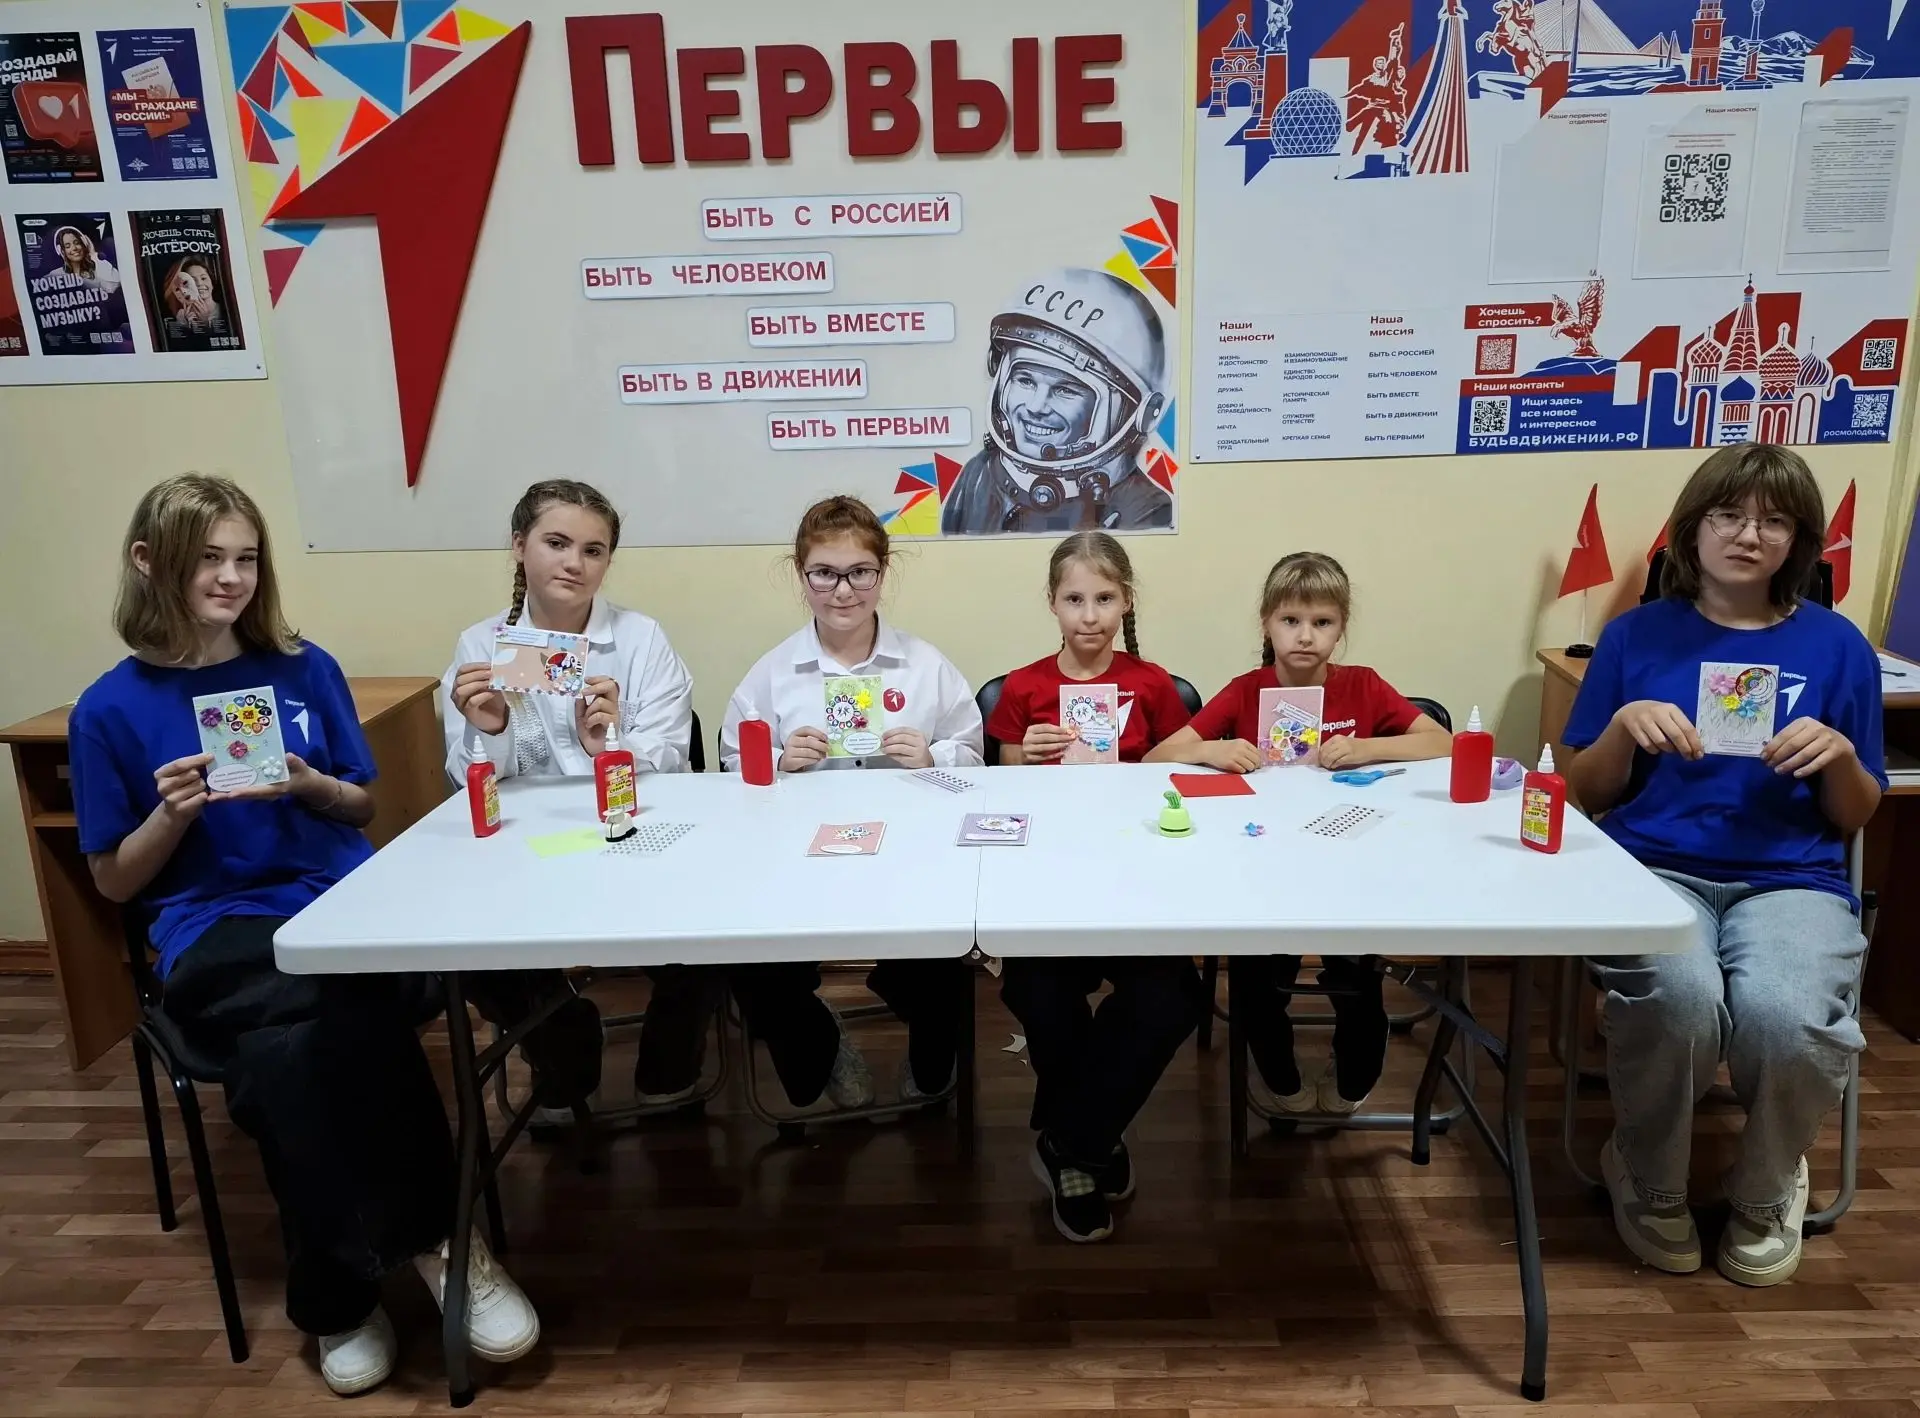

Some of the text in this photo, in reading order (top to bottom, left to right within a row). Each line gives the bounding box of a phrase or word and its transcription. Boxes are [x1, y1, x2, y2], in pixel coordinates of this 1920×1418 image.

[0, 48, 78, 71] ОЗДАВАЙ
[0, 67, 58, 85] РЕНДЫ
[134, 101, 198, 112] ГРАЖДАНЕ
[115, 112, 171, 122] РОССИИ!»
[1568, 112, 1608, 120] первичное
[1568, 118, 1608, 126] отделение
[705, 196, 950, 229] БЫТЬ С РОССИЕЙ
[143, 228, 215, 240] ХОЧЕШЬ СТАТЬ
[141, 239, 221, 257] АКТЁРОМ?
[585, 260, 827, 288] БЫТЬ ЧЕЛОВЕКОМ
[30, 272, 84, 293] ХОЧЕШЬ
[35, 287, 109, 311] СОЗДАВАТЬ
[1024, 284, 1105, 328] СССР
[40, 305, 101, 329] МУЗЫКУ?
[1478, 307, 1526, 317] Хочешь
[750, 311, 926, 336] БЫТЬ ВМЕСТЕ
[1370, 315, 1404, 324] Наша
[1477, 316, 1542, 328] спросить?
[1219, 321, 1253, 330] Наши
[1219, 333, 1275, 343] ценности
[1369, 328, 1414, 337] миссия
[1397, 348, 1435, 357] РОССИЕЙ
[1224, 359, 1268, 367] ДОСТОИНСТВО
[1390, 370, 1438, 378] ЧЕЛОВЕКОМ
[622, 367, 862, 393] БЫТЬ В ДВИЖЕНИИ
[1473, 381, 1565, 392] Наши контакты
[1521, 397, 1583, 407] Ищи здесь
[1394, 410, 1439, 419] ДВИЖЕНИИ
[1520, 409, 1578, 418] все новое
[771, 415, 950, 440] БЫТЬ ПЕРВЫМ
[1528, 419, 1597, 430] интересное
[1469, 432, 1639, 447] БУДЬВДВИЖЕНИИ.РФ
[1320, 718, 1356, 733] ервые
